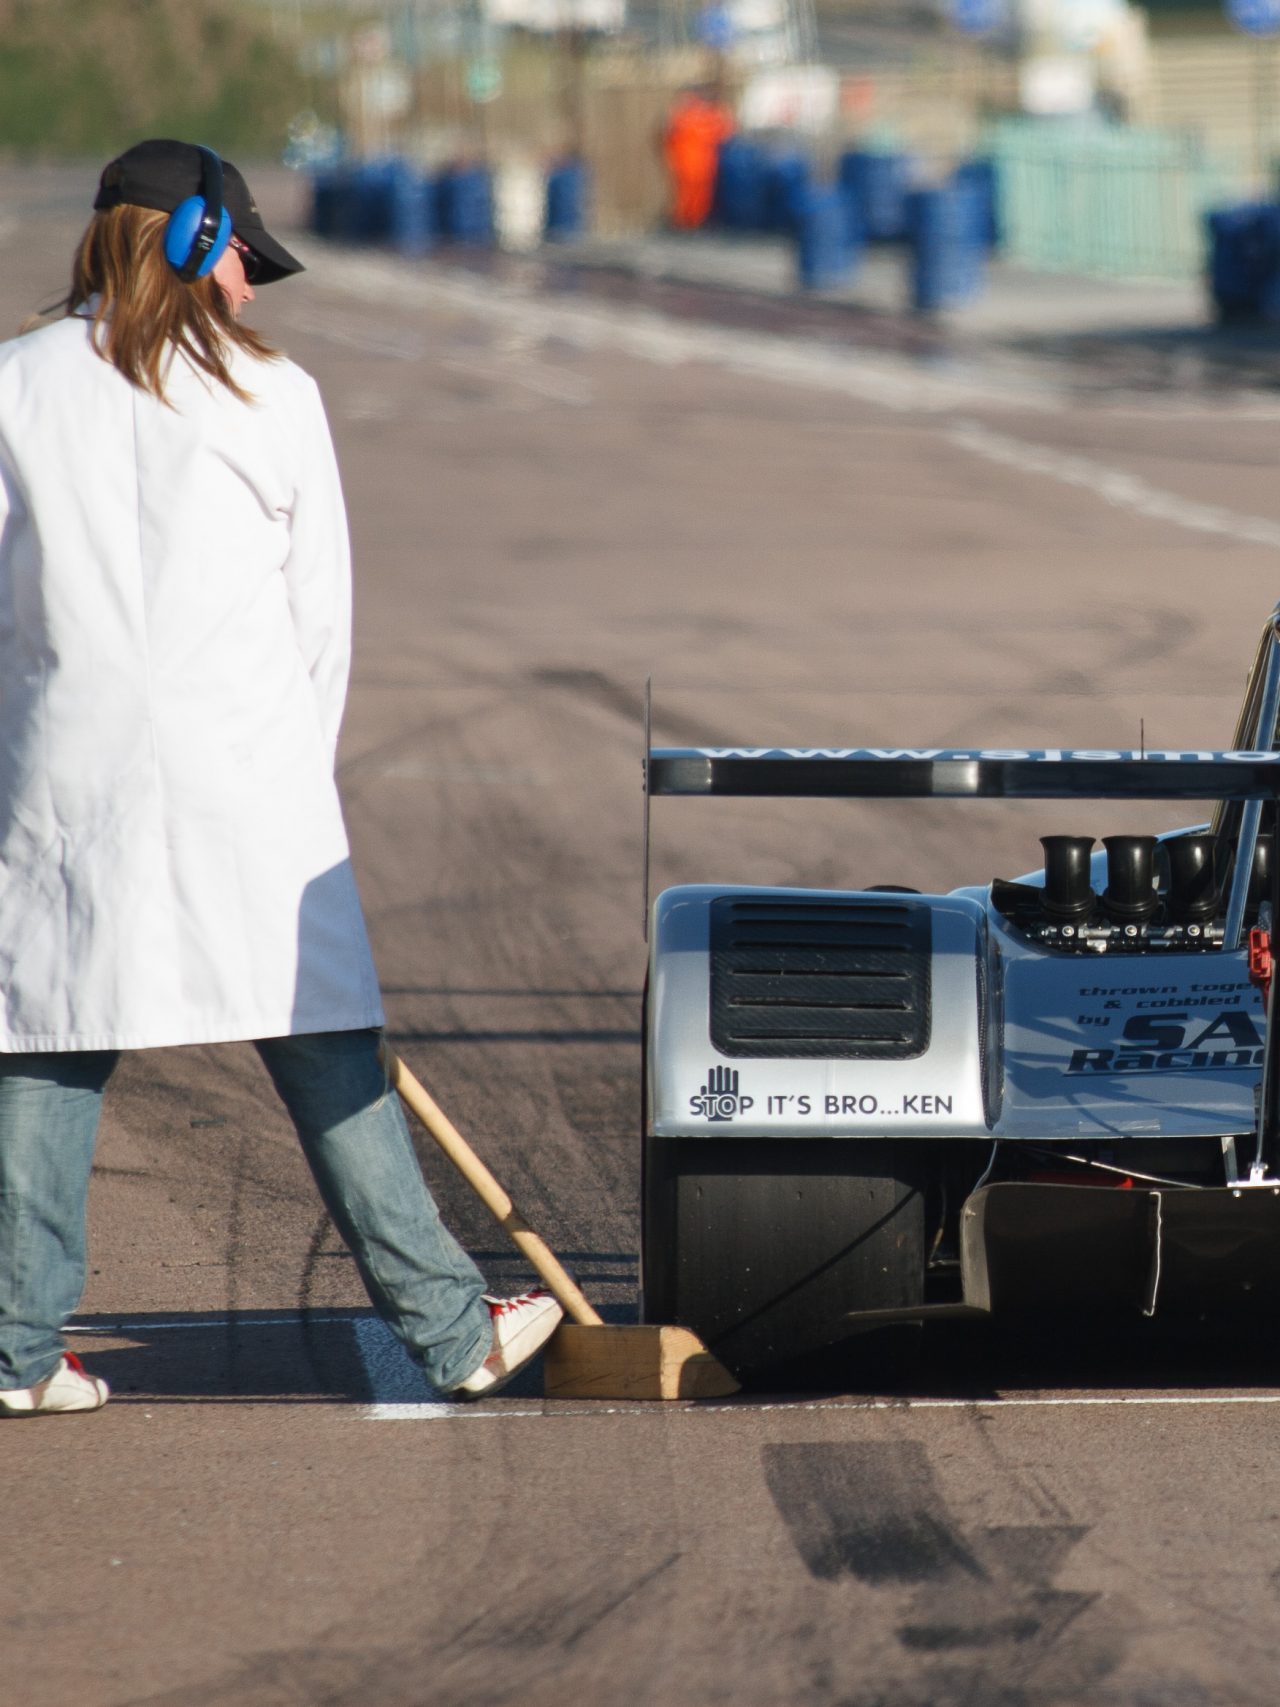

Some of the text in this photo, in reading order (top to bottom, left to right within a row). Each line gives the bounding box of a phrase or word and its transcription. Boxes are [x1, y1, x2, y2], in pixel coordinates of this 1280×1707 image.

[1078, 986, 1178, 997] thrown
[1103, 1000, 1122, 1010] &
[1136, 995, 1241, 1009] cobbled
[1077, 1014, 1111, 1027] by
[690, 1095, 953, 1116] STOP IT'S BRO...KEN
